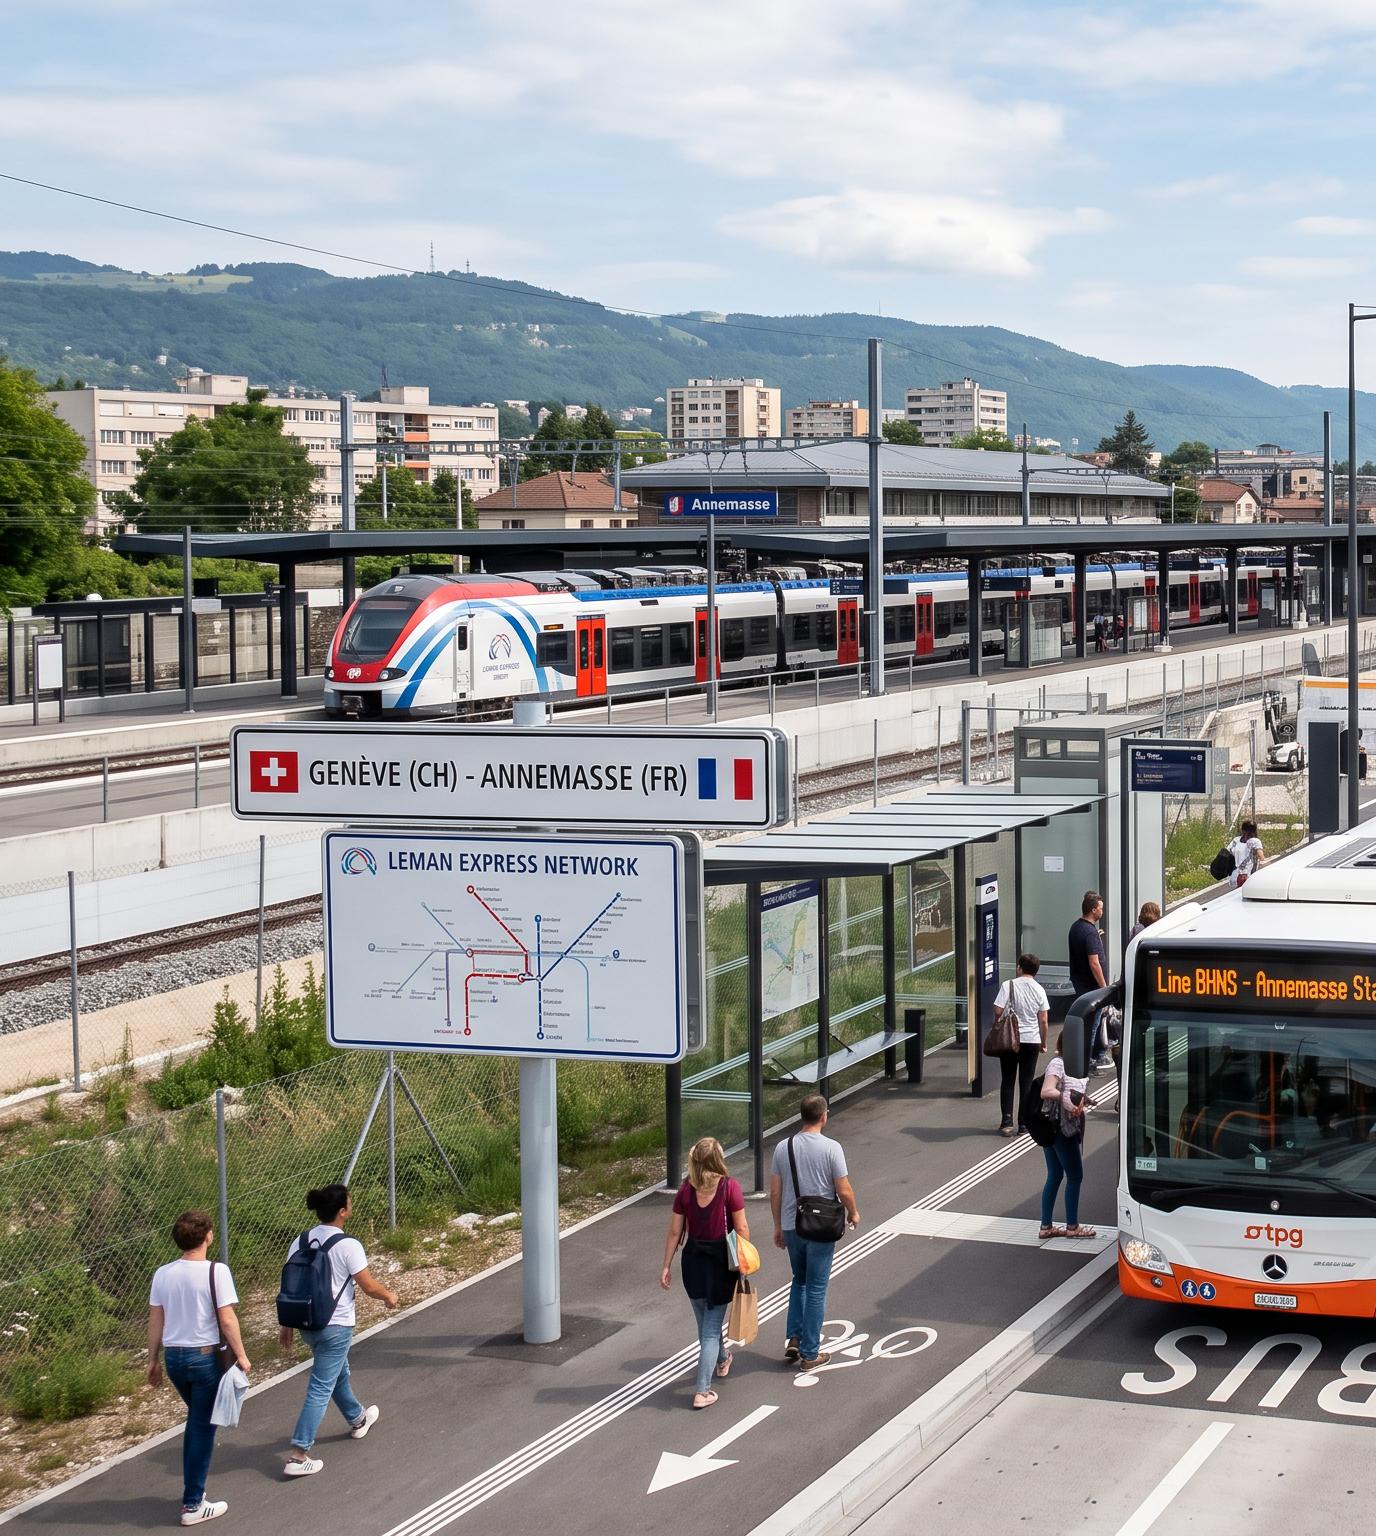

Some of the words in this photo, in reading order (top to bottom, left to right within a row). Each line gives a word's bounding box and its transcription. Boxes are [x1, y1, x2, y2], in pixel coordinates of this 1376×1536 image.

[691, 498, 770, 511] Annemasse
[309, 755, 400, 787] GENÈVE
[409, 760, 458, 793] (CH)
[480, 763, 633, 791] ANNEMASSE
[641, 764, 687, 797] (FR)
[388, 851, 453, 871] LEMAN
[459, 853, 538, 874] EXPRESS
[544, 855, 639, 877] NETWORK
[1157, 966, 1191, 993] Line
[1195, 968, 1238, 996] BHNS
[1256, 970, 1348, 1000] Annemasse
